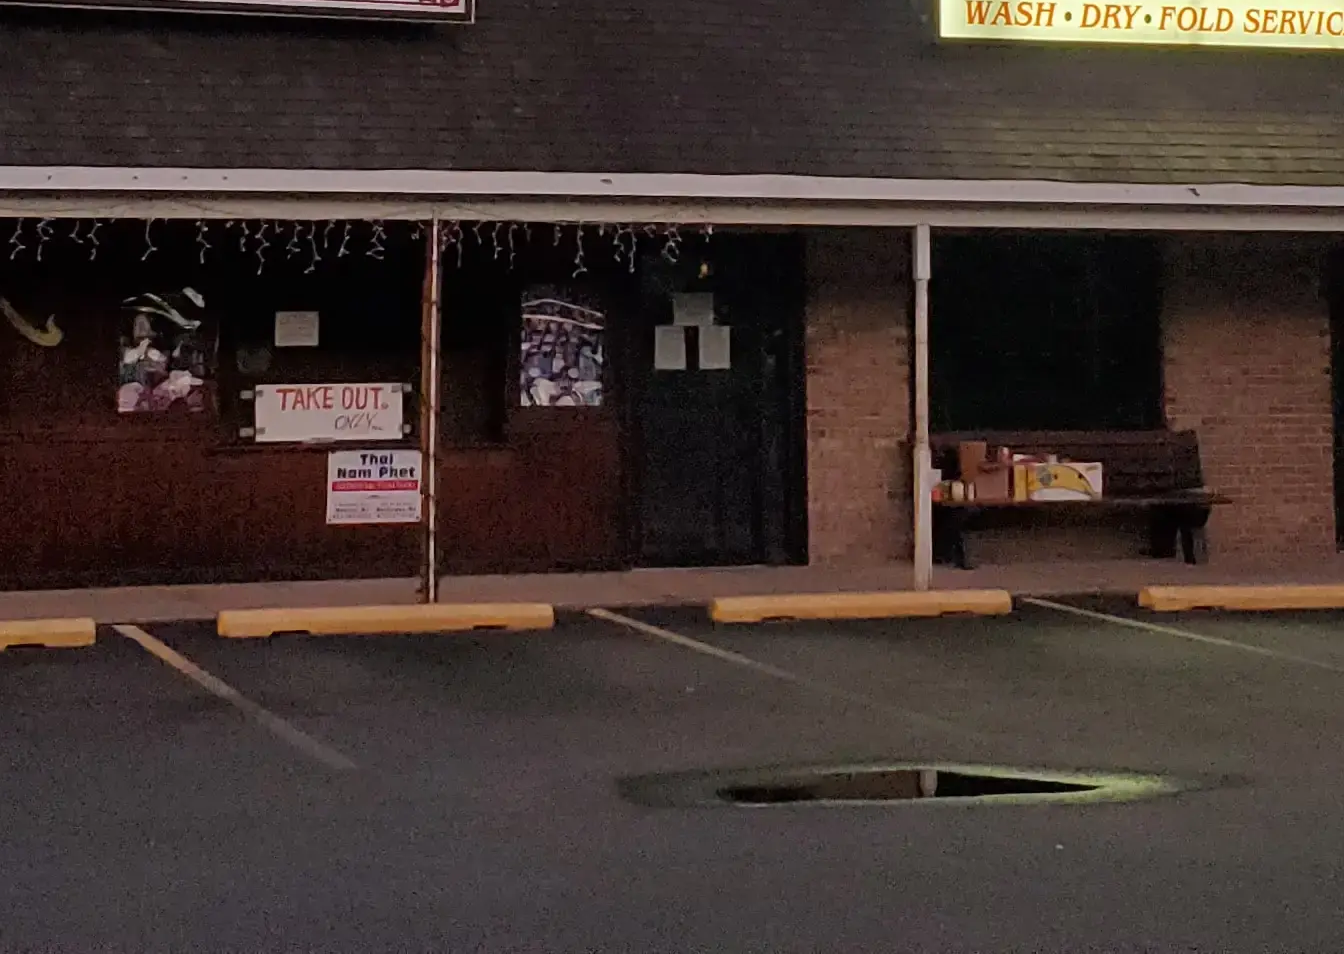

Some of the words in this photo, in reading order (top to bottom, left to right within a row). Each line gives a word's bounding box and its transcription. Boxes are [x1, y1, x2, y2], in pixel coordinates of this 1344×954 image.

[1079, 2, 1144, 32] DRY
[1158, 5, 1235, 34] FOLD
[275, 386, 334, 411] TAKE
[359, 452, 394, 466] Thai
[336, 466, 373, 479] Nam
[378, 465, 417, 479] Phet
